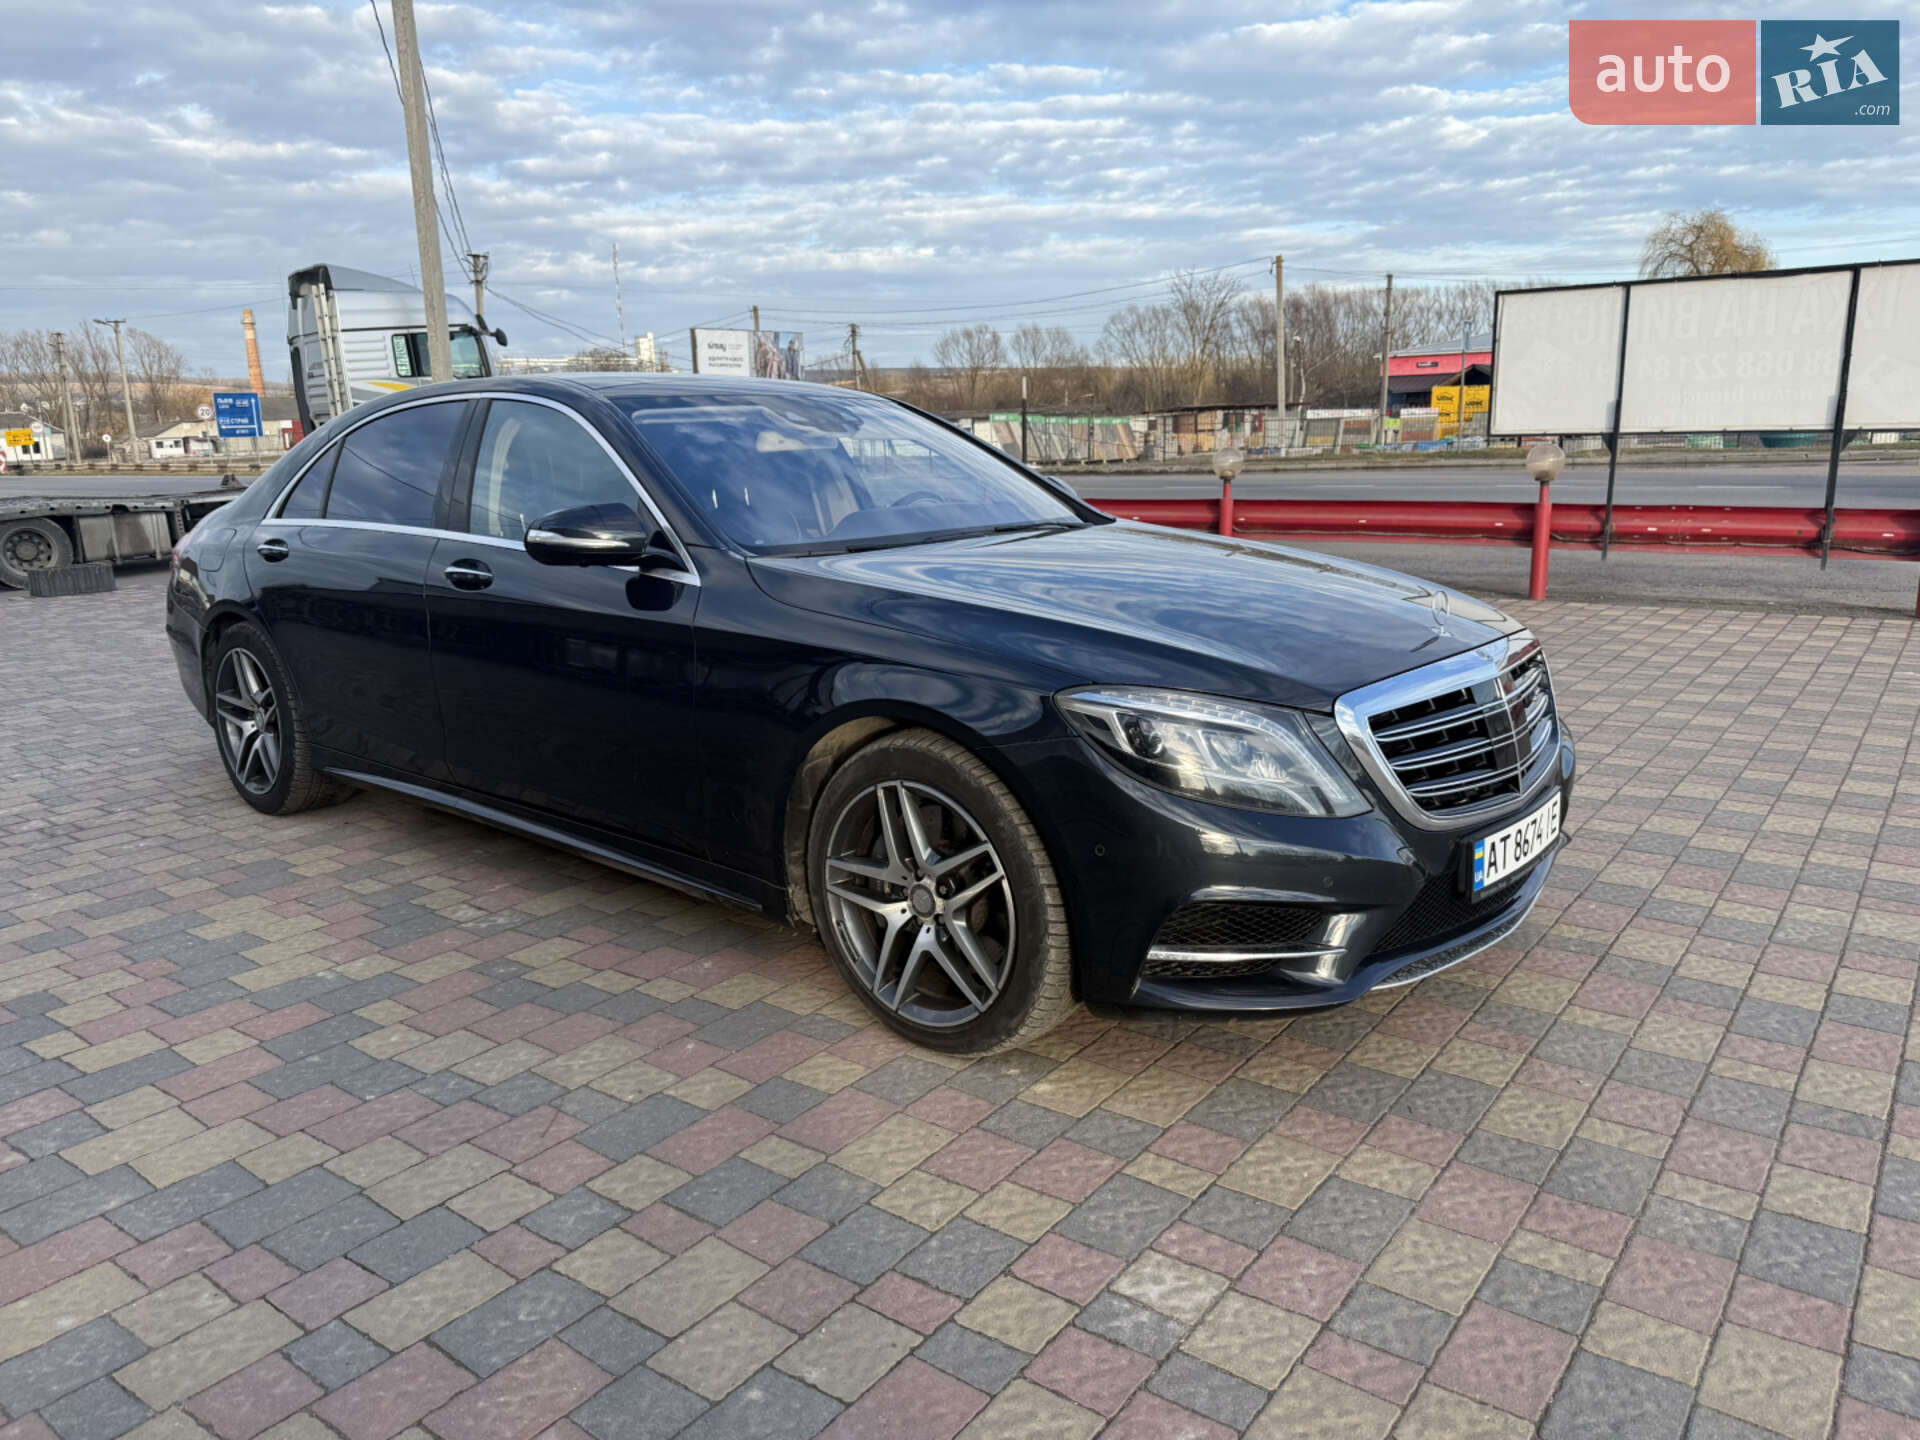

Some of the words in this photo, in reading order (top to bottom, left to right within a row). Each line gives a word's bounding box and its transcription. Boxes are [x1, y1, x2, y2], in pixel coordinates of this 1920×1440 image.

[1486, 834, 1511, 878] AT
[1514, 813, 1543, 862] 8674
[1546, 801, 1558, 840] IE
[1474, 870, 1484, 882] UA
